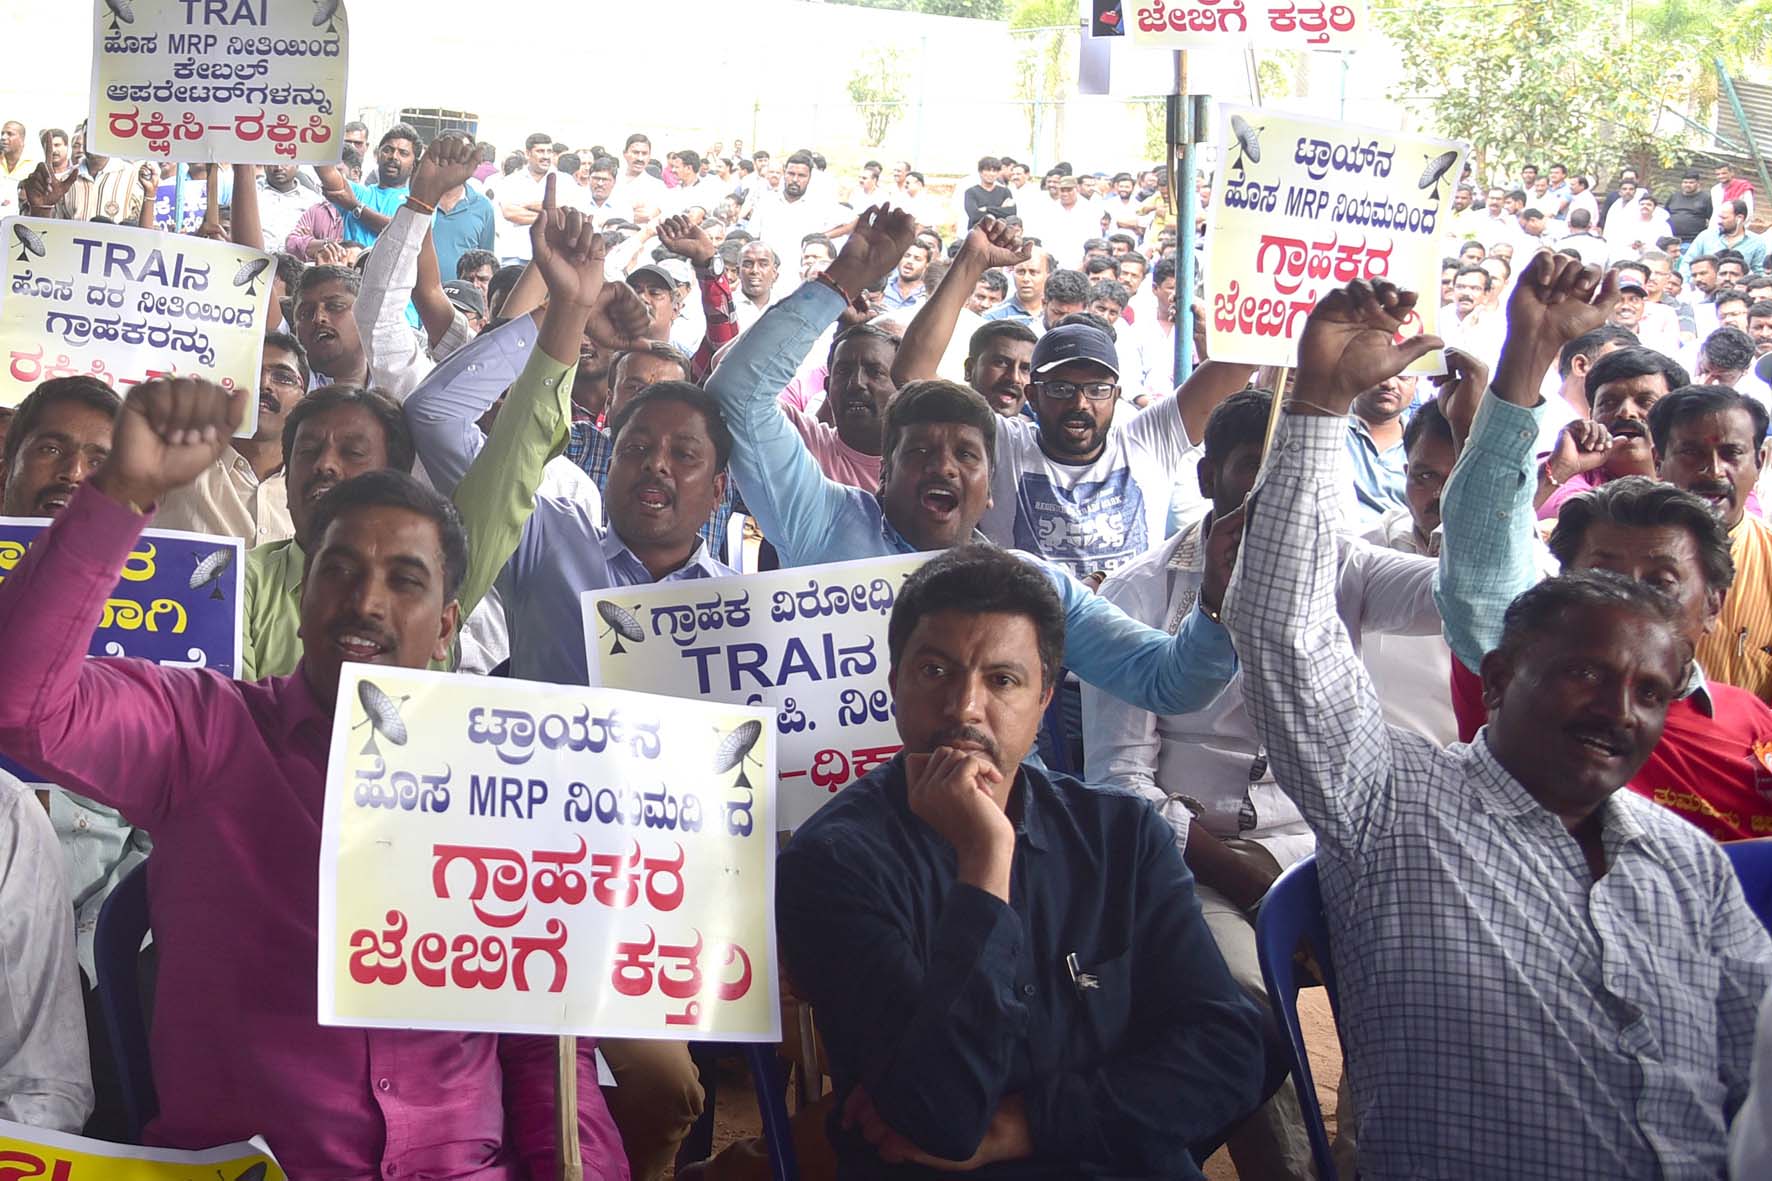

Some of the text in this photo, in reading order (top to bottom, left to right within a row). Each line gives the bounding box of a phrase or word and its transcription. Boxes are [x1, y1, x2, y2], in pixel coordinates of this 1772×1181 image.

[179, 0, 268, 25] TRAI
[1268, 0, 1356, 43] ಕತ್ತರಿ
[104, 31, 340, 57] ಹೊಸ MRP ನೀತಿಯಿಂದ
[174, 57, 268, 80] ಕೇಬಲ್
[1225, 171, 1439, 234] ಹೊಸ MRP ನಿಯಮದಿಂದ
[1256, 230, 1393, 295] ಗ್ರಾಹಕರ
[12, 270, 255, 328] ಹೊಸ ದರ ನೀತಿಯಿಂದ
[46, 311, 216, 368] ಗ್ರಾಹಕರನ್ನು
[650, 589, 750, 646] ಗ್ರಾಹಕ
[354, 757, 451, 813] ಹೊಸ
[469, 775, 548, 819] MRP
[432, 833, 685, 928] ಗ್ರಾಹಕರ
[349, 909, 568, 993] ಜೇಬಿಗೆ
